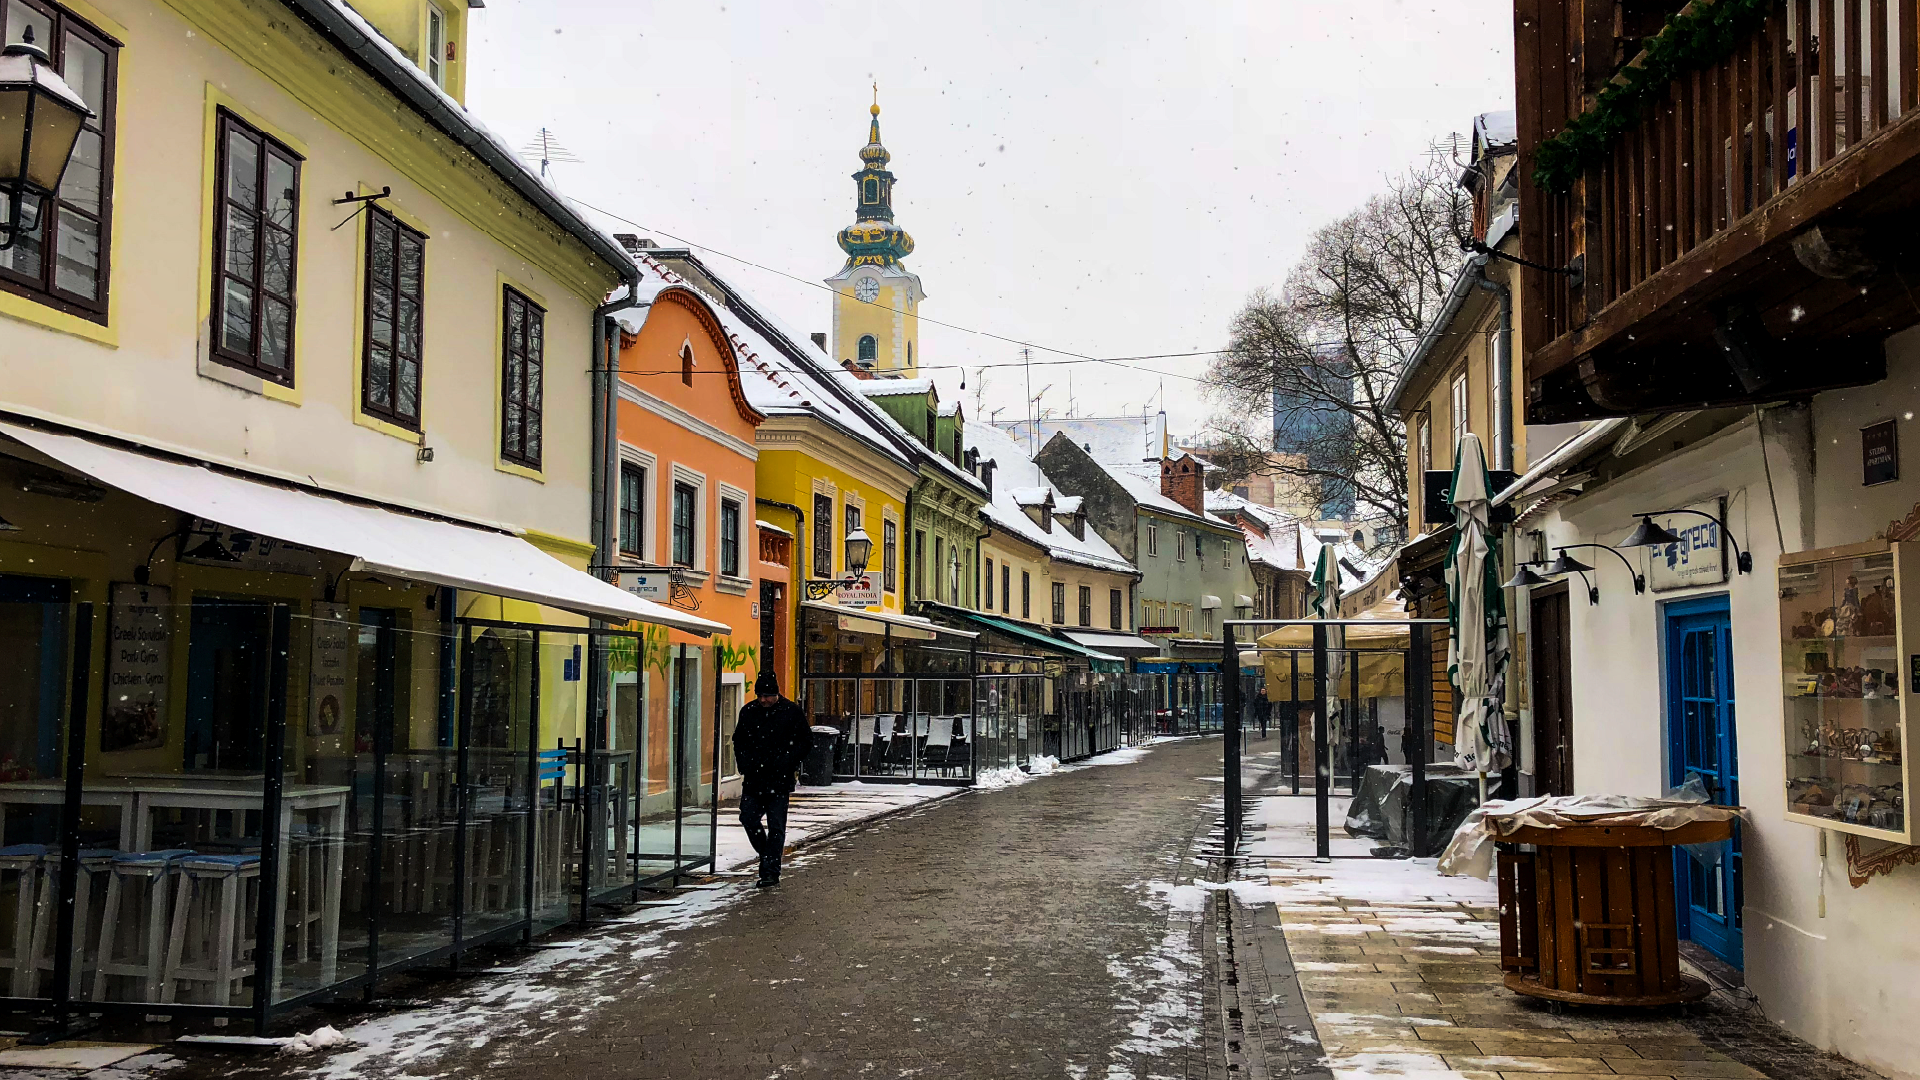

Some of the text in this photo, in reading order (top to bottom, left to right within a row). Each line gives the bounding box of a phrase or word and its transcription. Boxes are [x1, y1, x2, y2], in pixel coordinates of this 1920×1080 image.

[121, 650, 159, 665] Pork Gyros
[113, 673, 165, 687] Chicken Gyros
